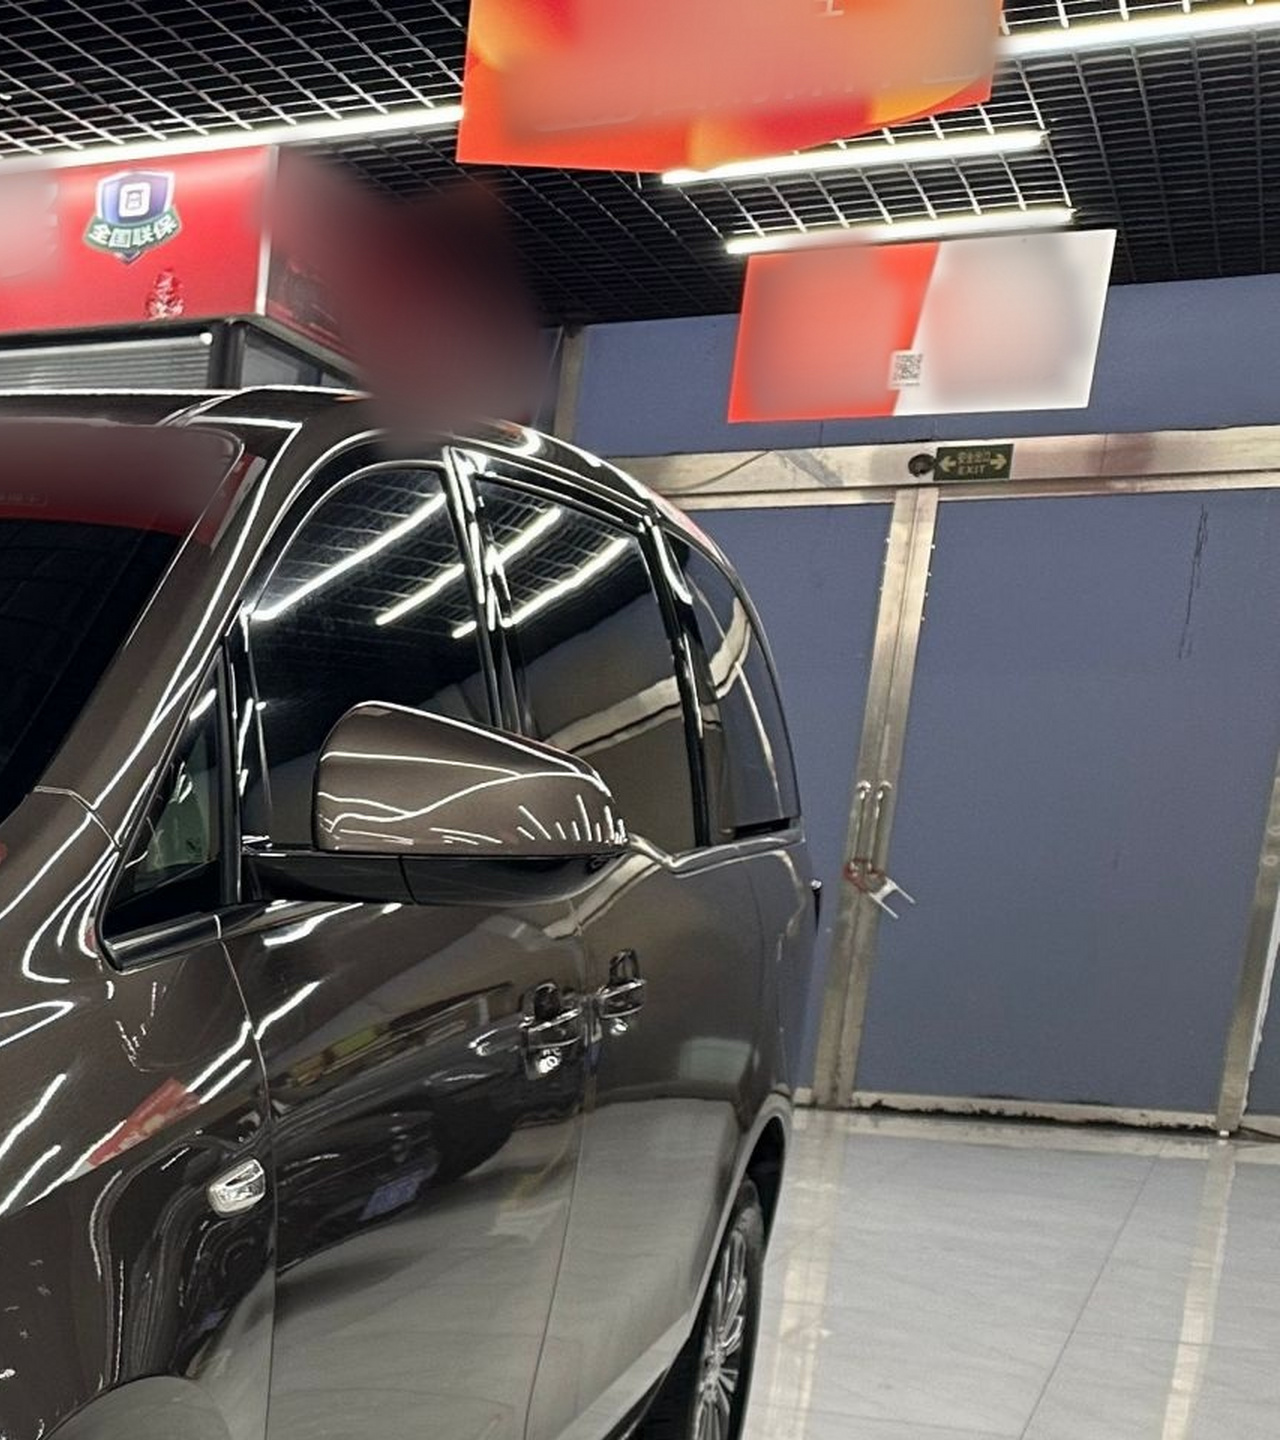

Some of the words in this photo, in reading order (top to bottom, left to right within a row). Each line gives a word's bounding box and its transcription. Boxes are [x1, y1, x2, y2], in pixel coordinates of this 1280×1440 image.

[88, 215, 177, 247] 全国联保
[958, 465, 985, 475] EXIT
